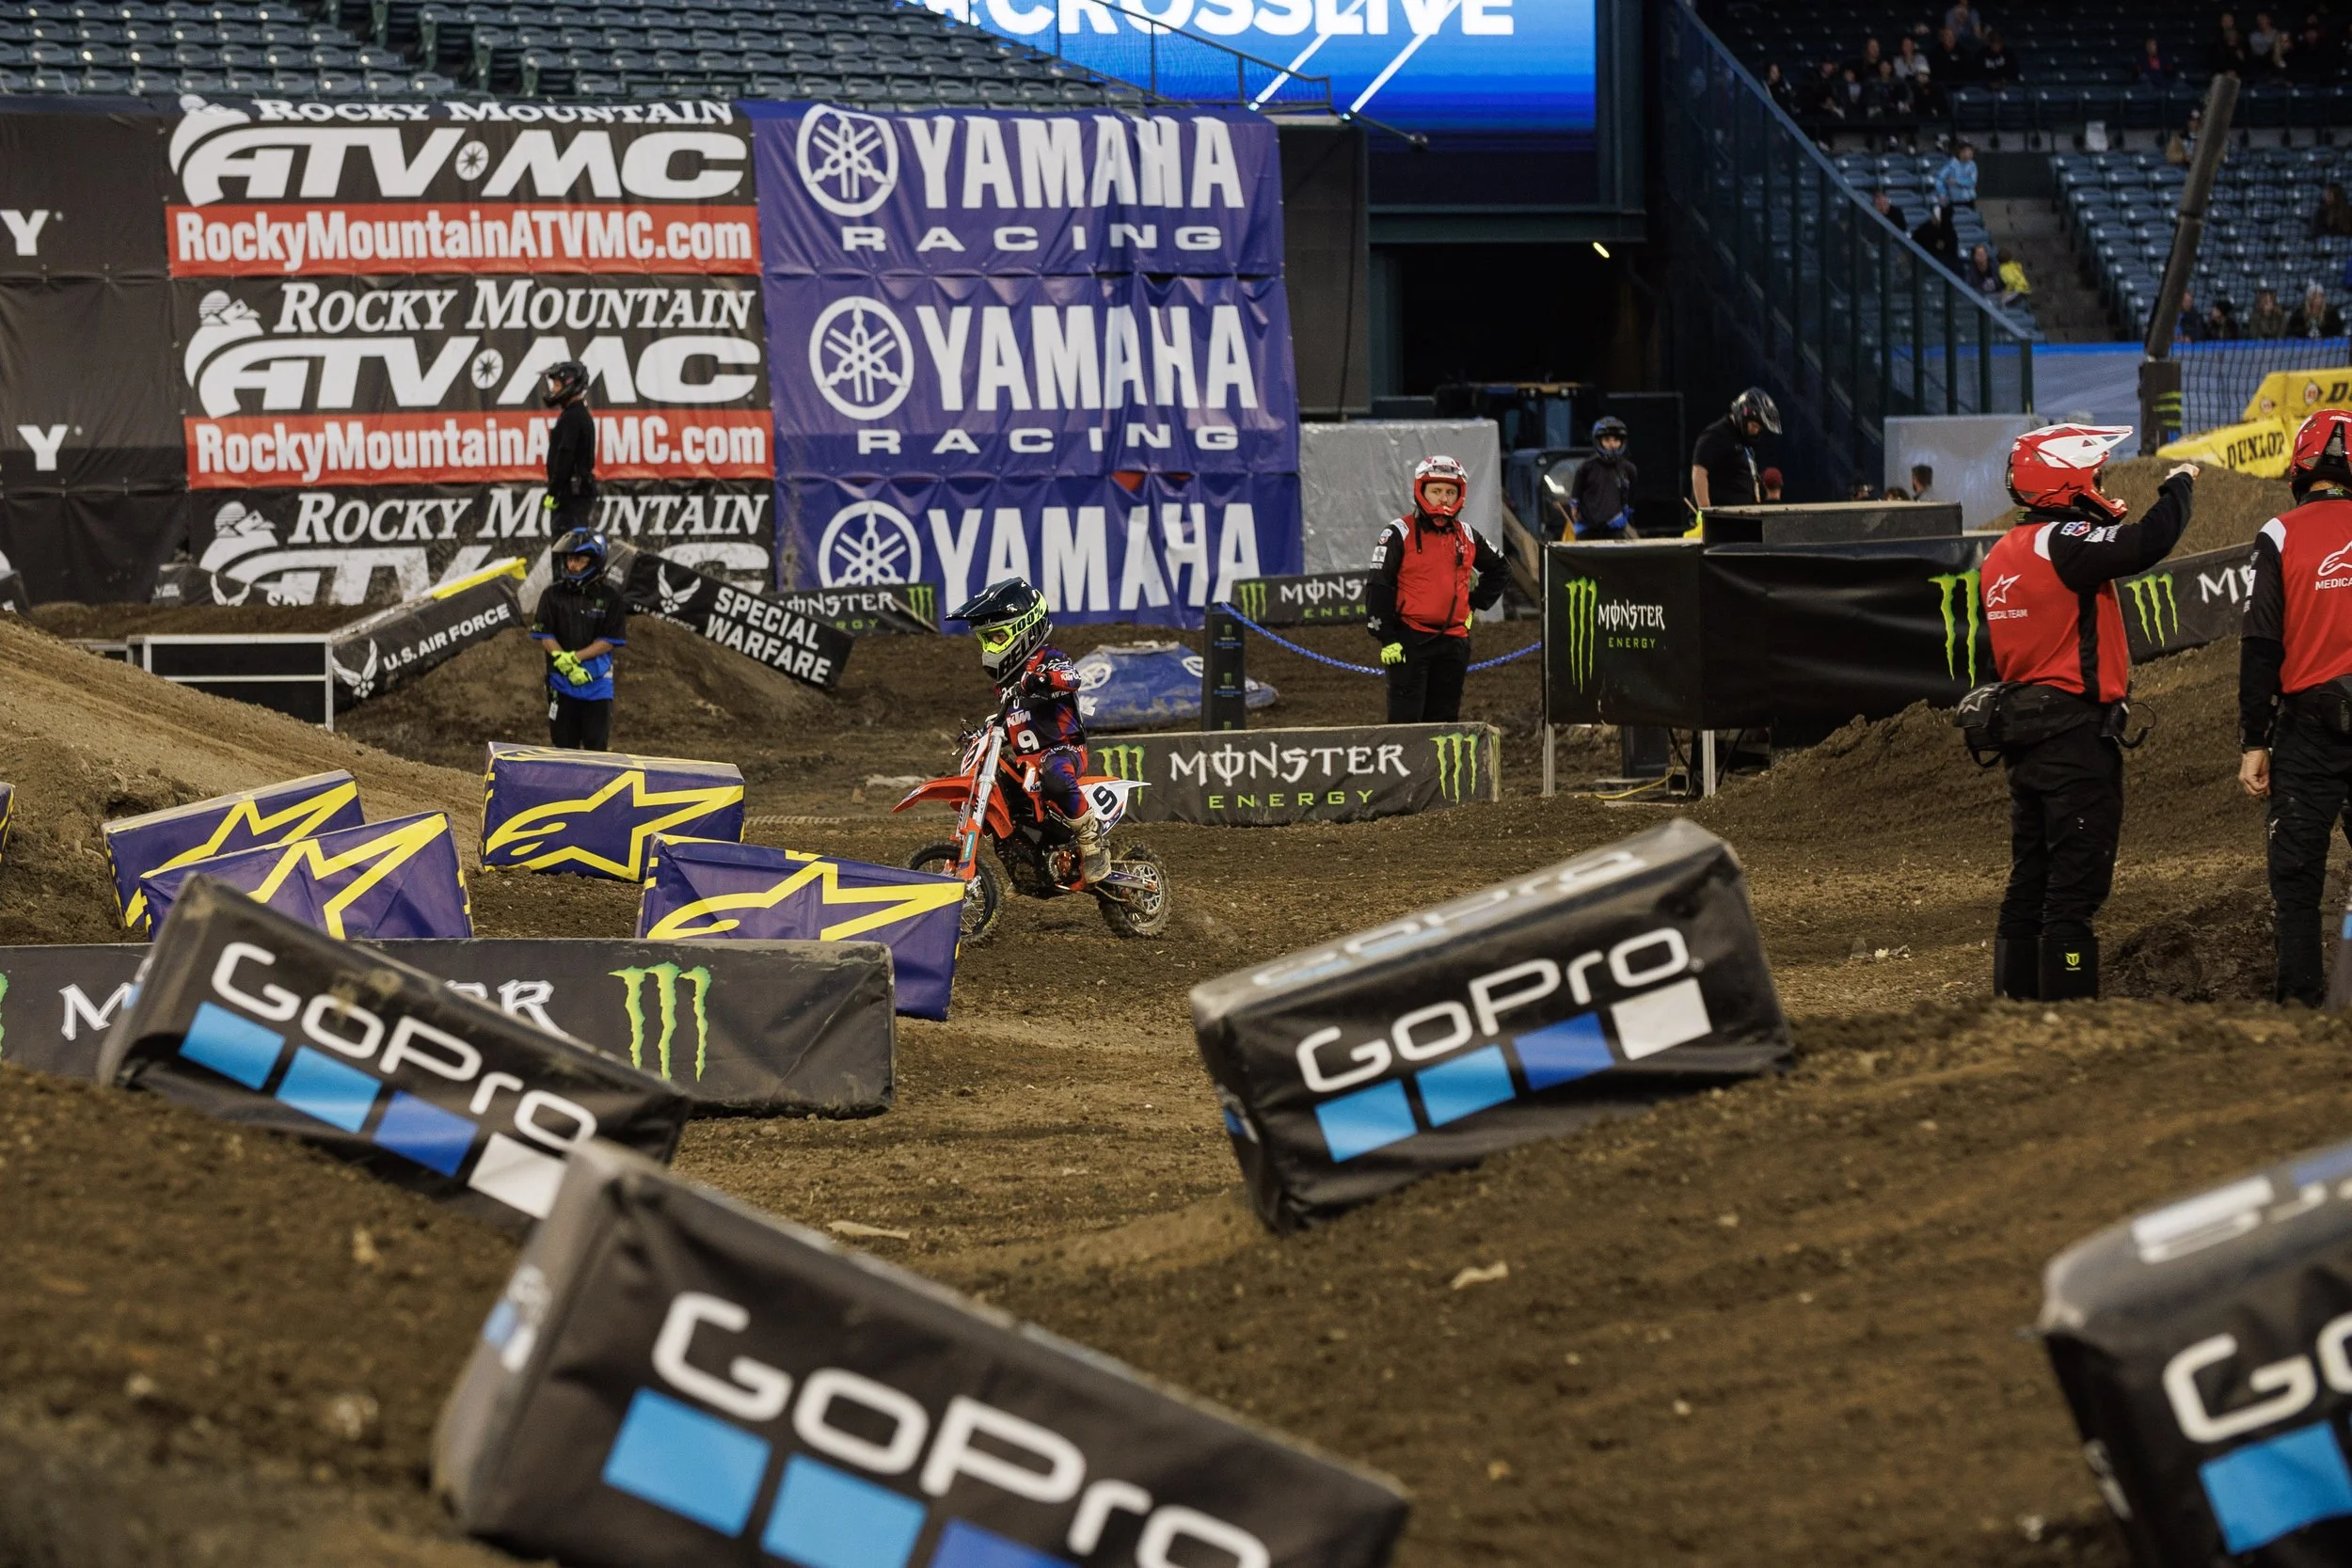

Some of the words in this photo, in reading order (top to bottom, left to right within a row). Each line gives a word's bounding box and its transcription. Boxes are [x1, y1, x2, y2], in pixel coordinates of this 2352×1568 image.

[906, 115, 1245, 209] YAMAHA
[175, 210, 753, 272] RockyMountainATVMC.com
[841, 225, 1222, 253] RACING
[272, 282, 459, 333] ROCKY
[465, 278, 756, 330] MOUNTAIN
[915, 305, 1258, 411] YAMAHA
[857, 423, 1239, 454] RACING
[2227, 431, 2285, 470] DUNLOP
[287, 492, 473, 545] ROCKY
[929, 502, 1262, 613] YAMAHA
[382, 647, 418, 673] U.S.
[418, 629, 449, 662] AIR
[448, 602, 512, 641] FORCE
[714, 587, 819, 651] SPECIAL
[1009, 604, 1044, 637] 100%
[1598, 598, 1665, 631] MONSTER
[705, 613, 832, 685] WARFARE
[1608, 635, 1656, 650] ENERGY
[1006, 709, 1032, 728] KTM
[1017, 729, 1041, 753] 9
[1169, 741, 1411, 786] MONSTER
[1092, 784, 1119, 816] 9
[1208, 788, 1375, 809] ENERGY
[1295, 927, 1690, 1094] GoPro
[212, 942, 597, 1150] GoPro
[652, 1291, 1272, 1568] GoPro
